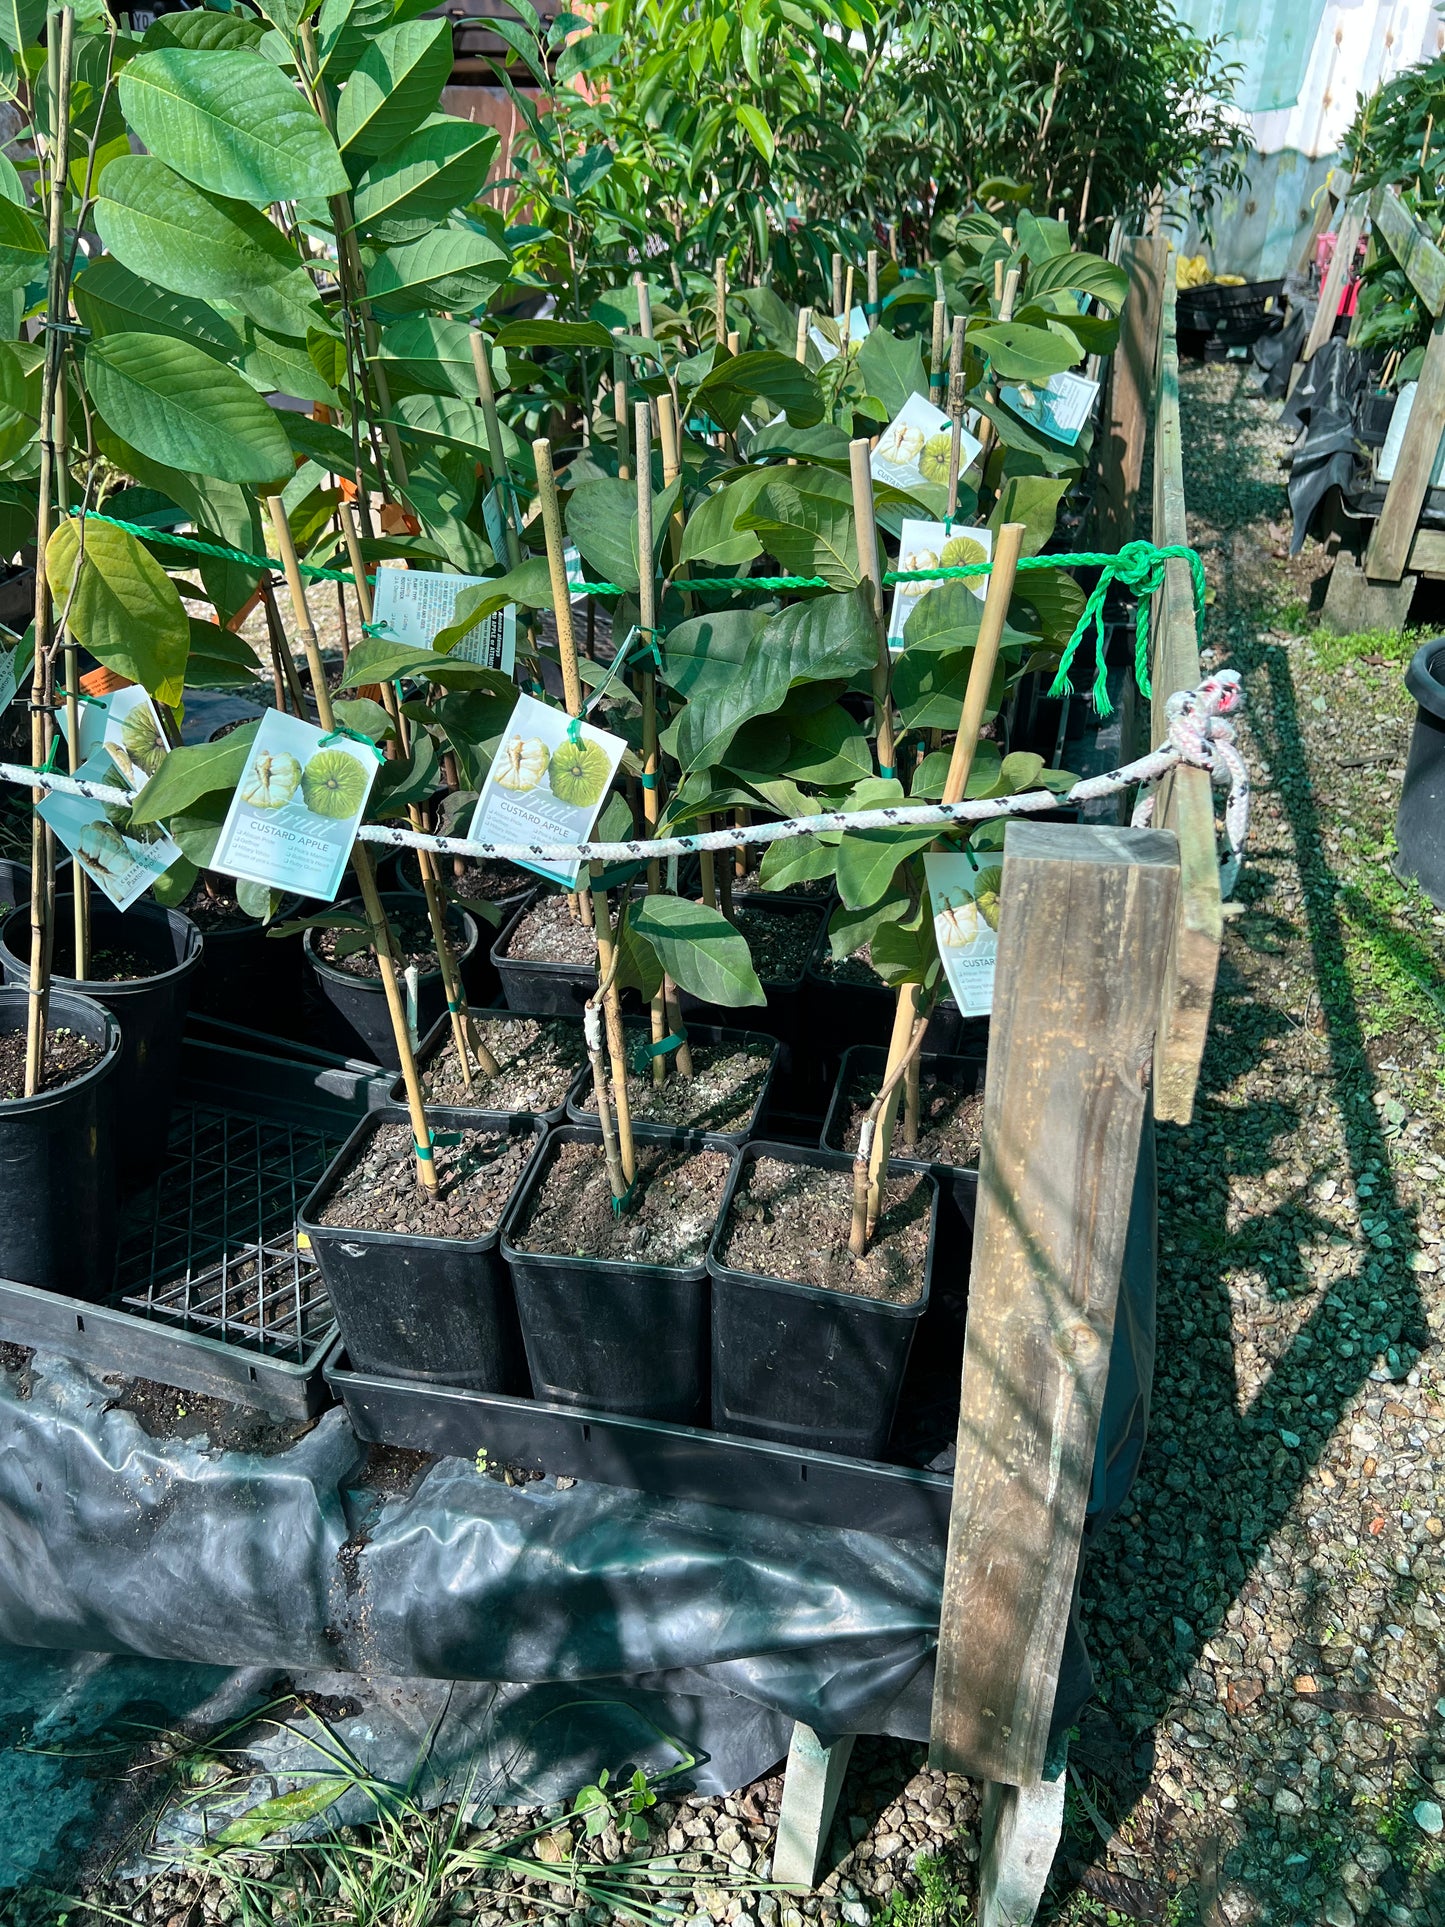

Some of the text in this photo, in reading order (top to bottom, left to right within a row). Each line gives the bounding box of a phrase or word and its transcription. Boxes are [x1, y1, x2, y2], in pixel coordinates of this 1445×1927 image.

[253, 798, 338, 838] Fruit
[500, 801, 541, 825] CUSTARD
[542, 821, 569, 838] APPLE
[503, 783, 579, 824] Fruit
[250, 821, 329, 852] CUSTARD APPLE
[121, 846, 159, 884] CUSTARD APPLE
[962, 959, 995, 967] CUSTAR
